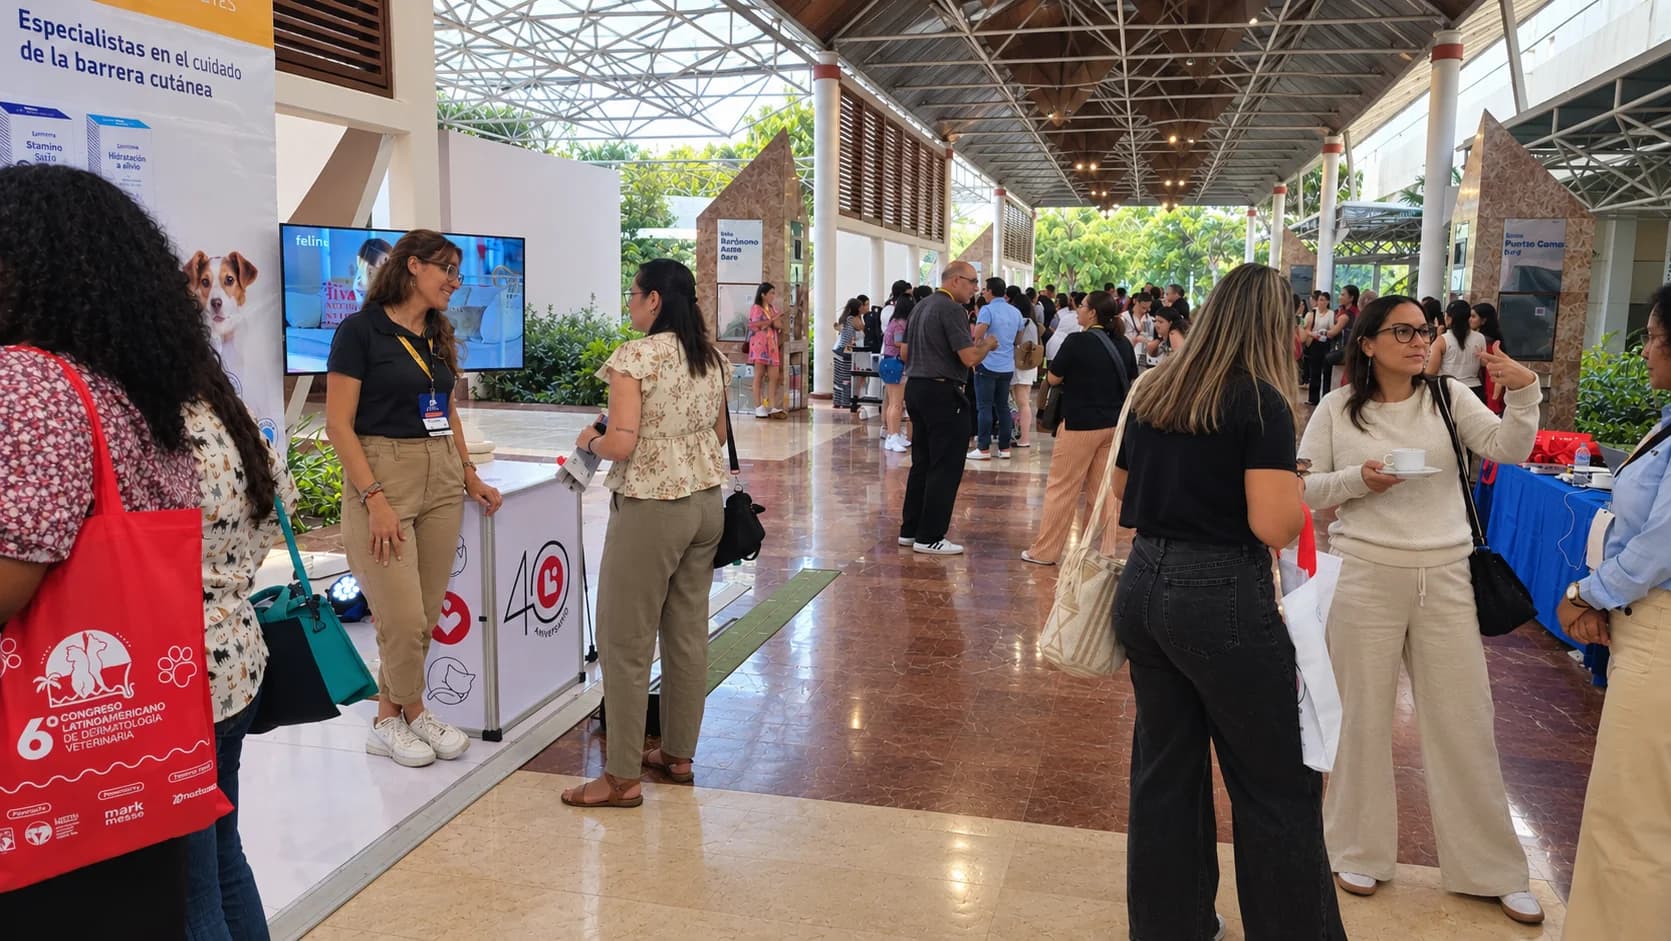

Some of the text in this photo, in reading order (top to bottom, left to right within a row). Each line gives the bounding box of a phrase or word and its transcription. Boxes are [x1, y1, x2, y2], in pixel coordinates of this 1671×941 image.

[18, 8, 242, 80] Especialistas en el cuidado
[20, 41, 213, 98] de la barrera cutánea
[60, 702, 122, 722] CONGRESO
[62, 702, 166, 732] LATINOAMERICANO
[63, 732, 78, 744] DE
[65, 730, 135, 753] VETERINARIA
[105, 801, 144, 819] mark
